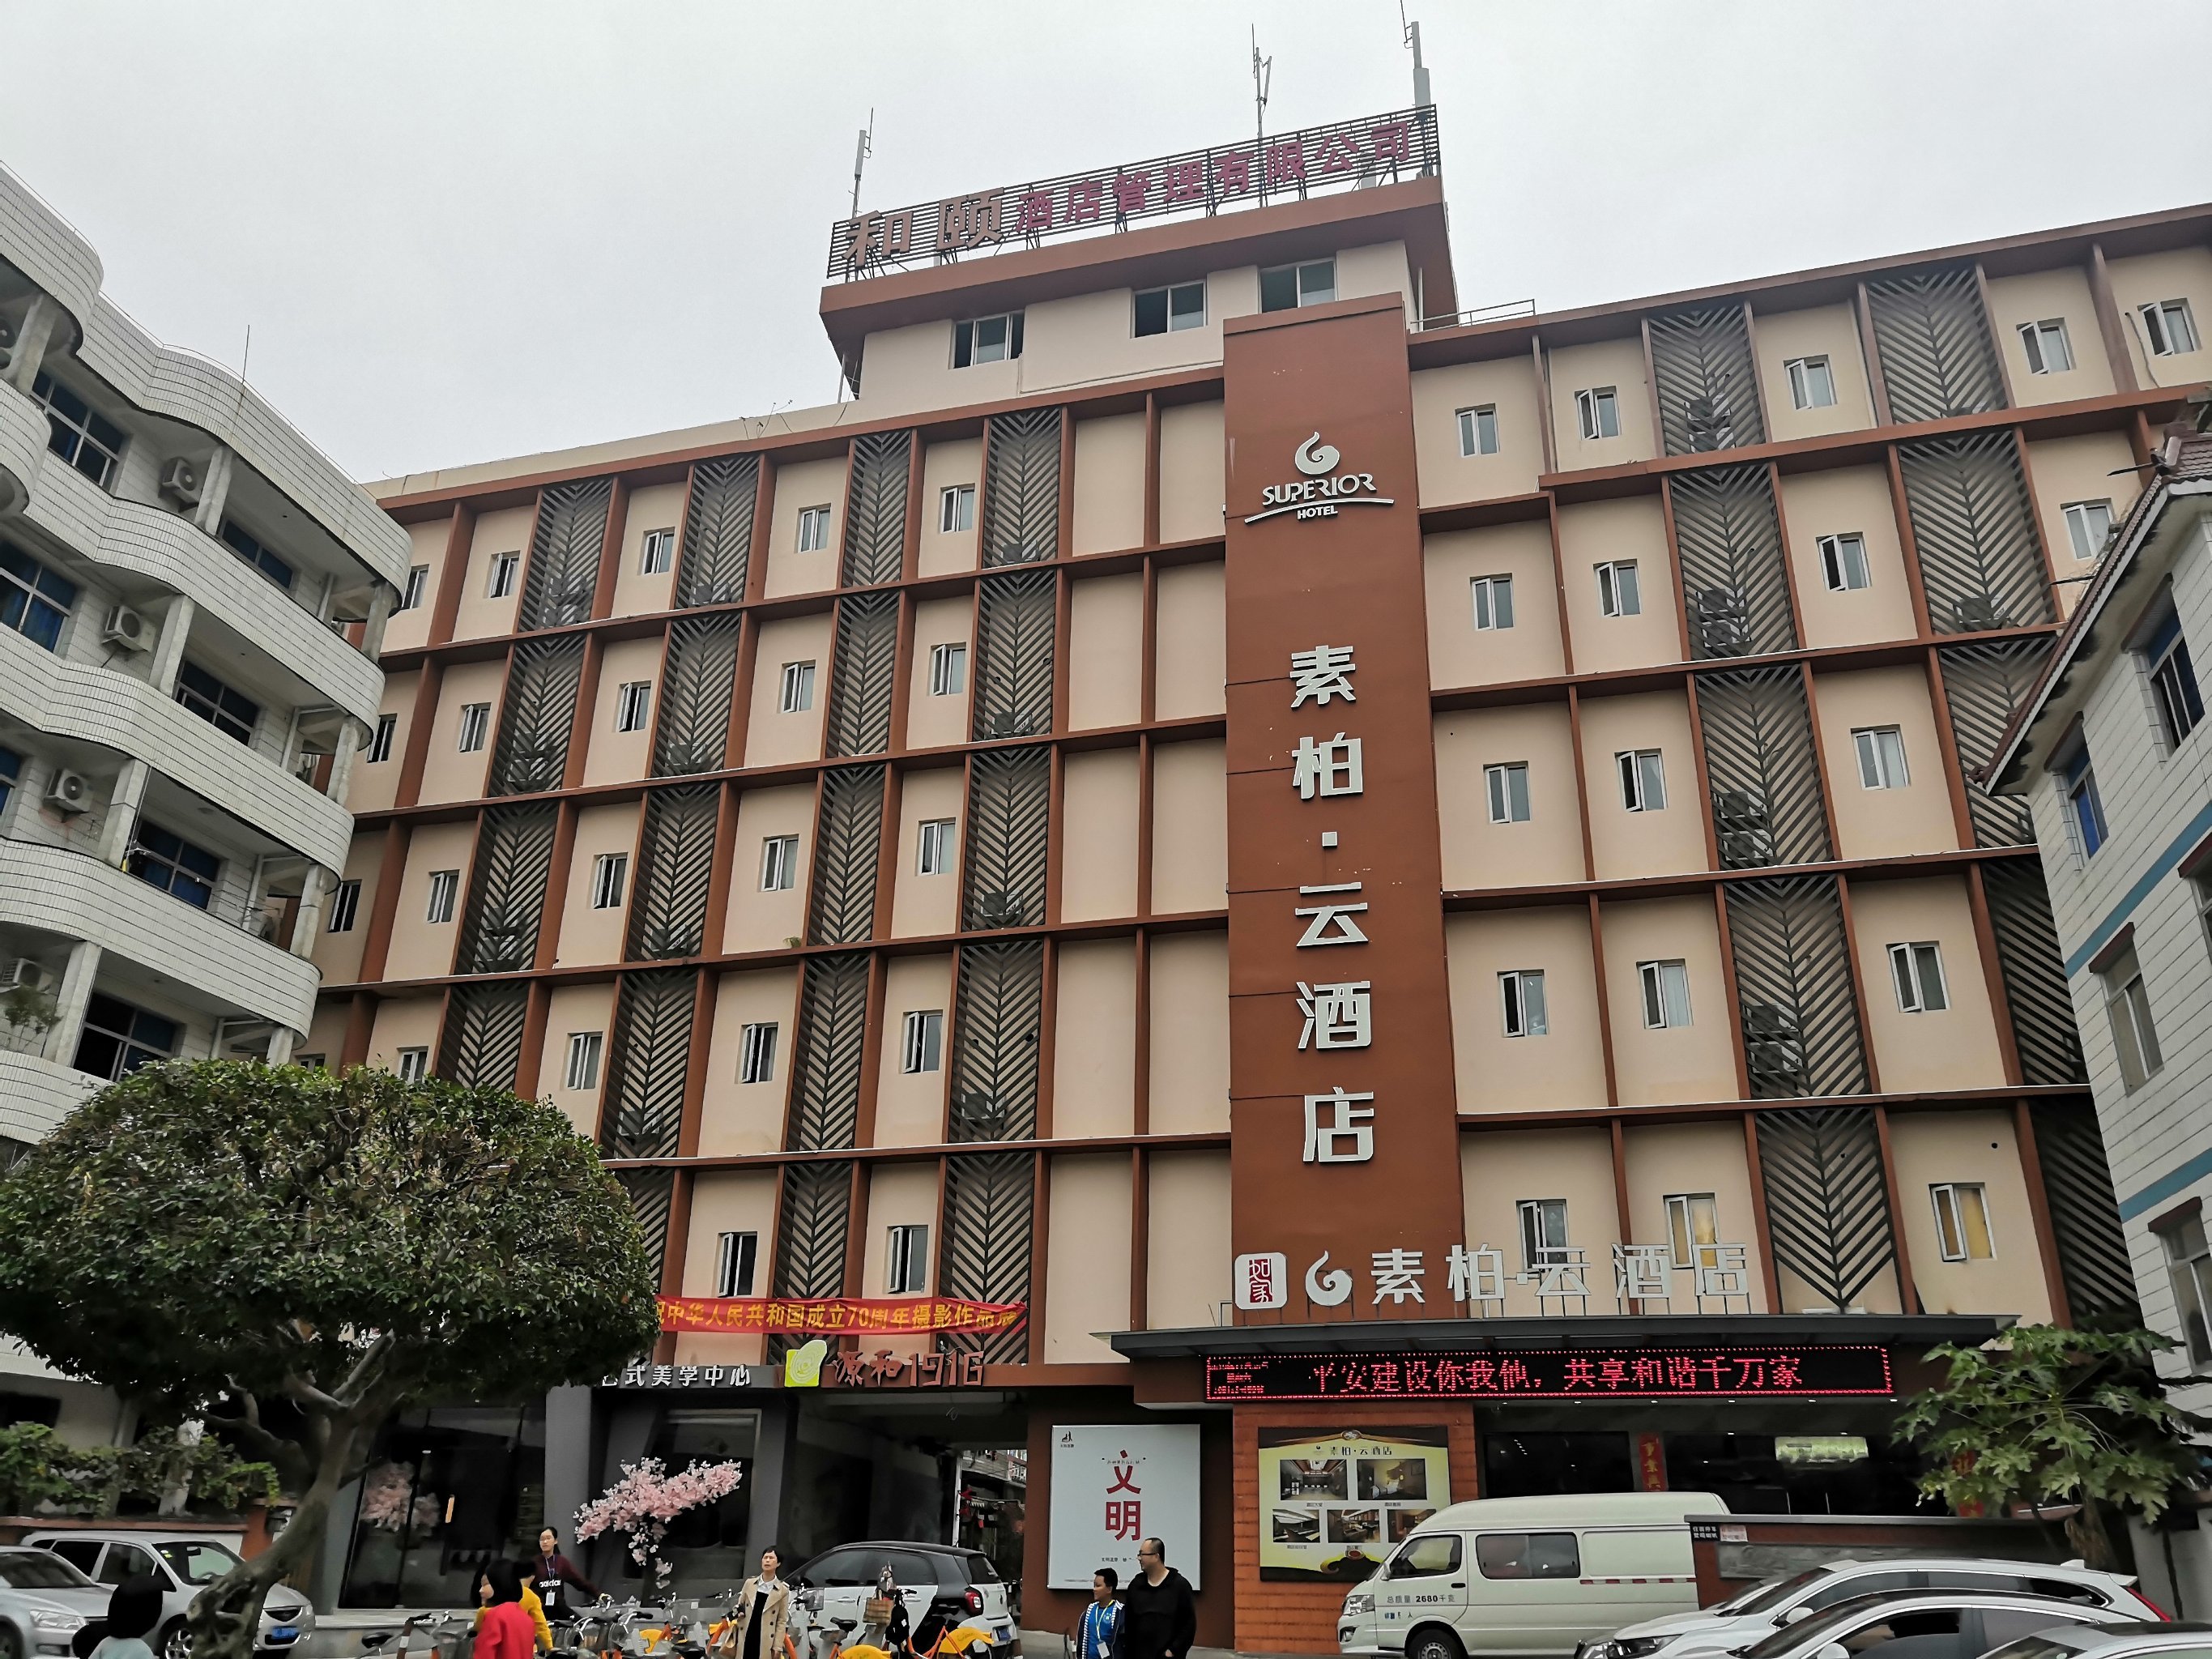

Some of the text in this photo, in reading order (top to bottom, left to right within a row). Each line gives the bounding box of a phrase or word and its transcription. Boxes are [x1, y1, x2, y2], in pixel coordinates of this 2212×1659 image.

[842, 122, 1412, 267] 和颐酒店管理有限公司
[1262, 473, 1377, 505] SUPERIOR
[1297, 505, 1338, 520] HOTEL
[831, 1349, 985, 1387] 源和1916
[1105, 1449, 1142, 1541] 文明
